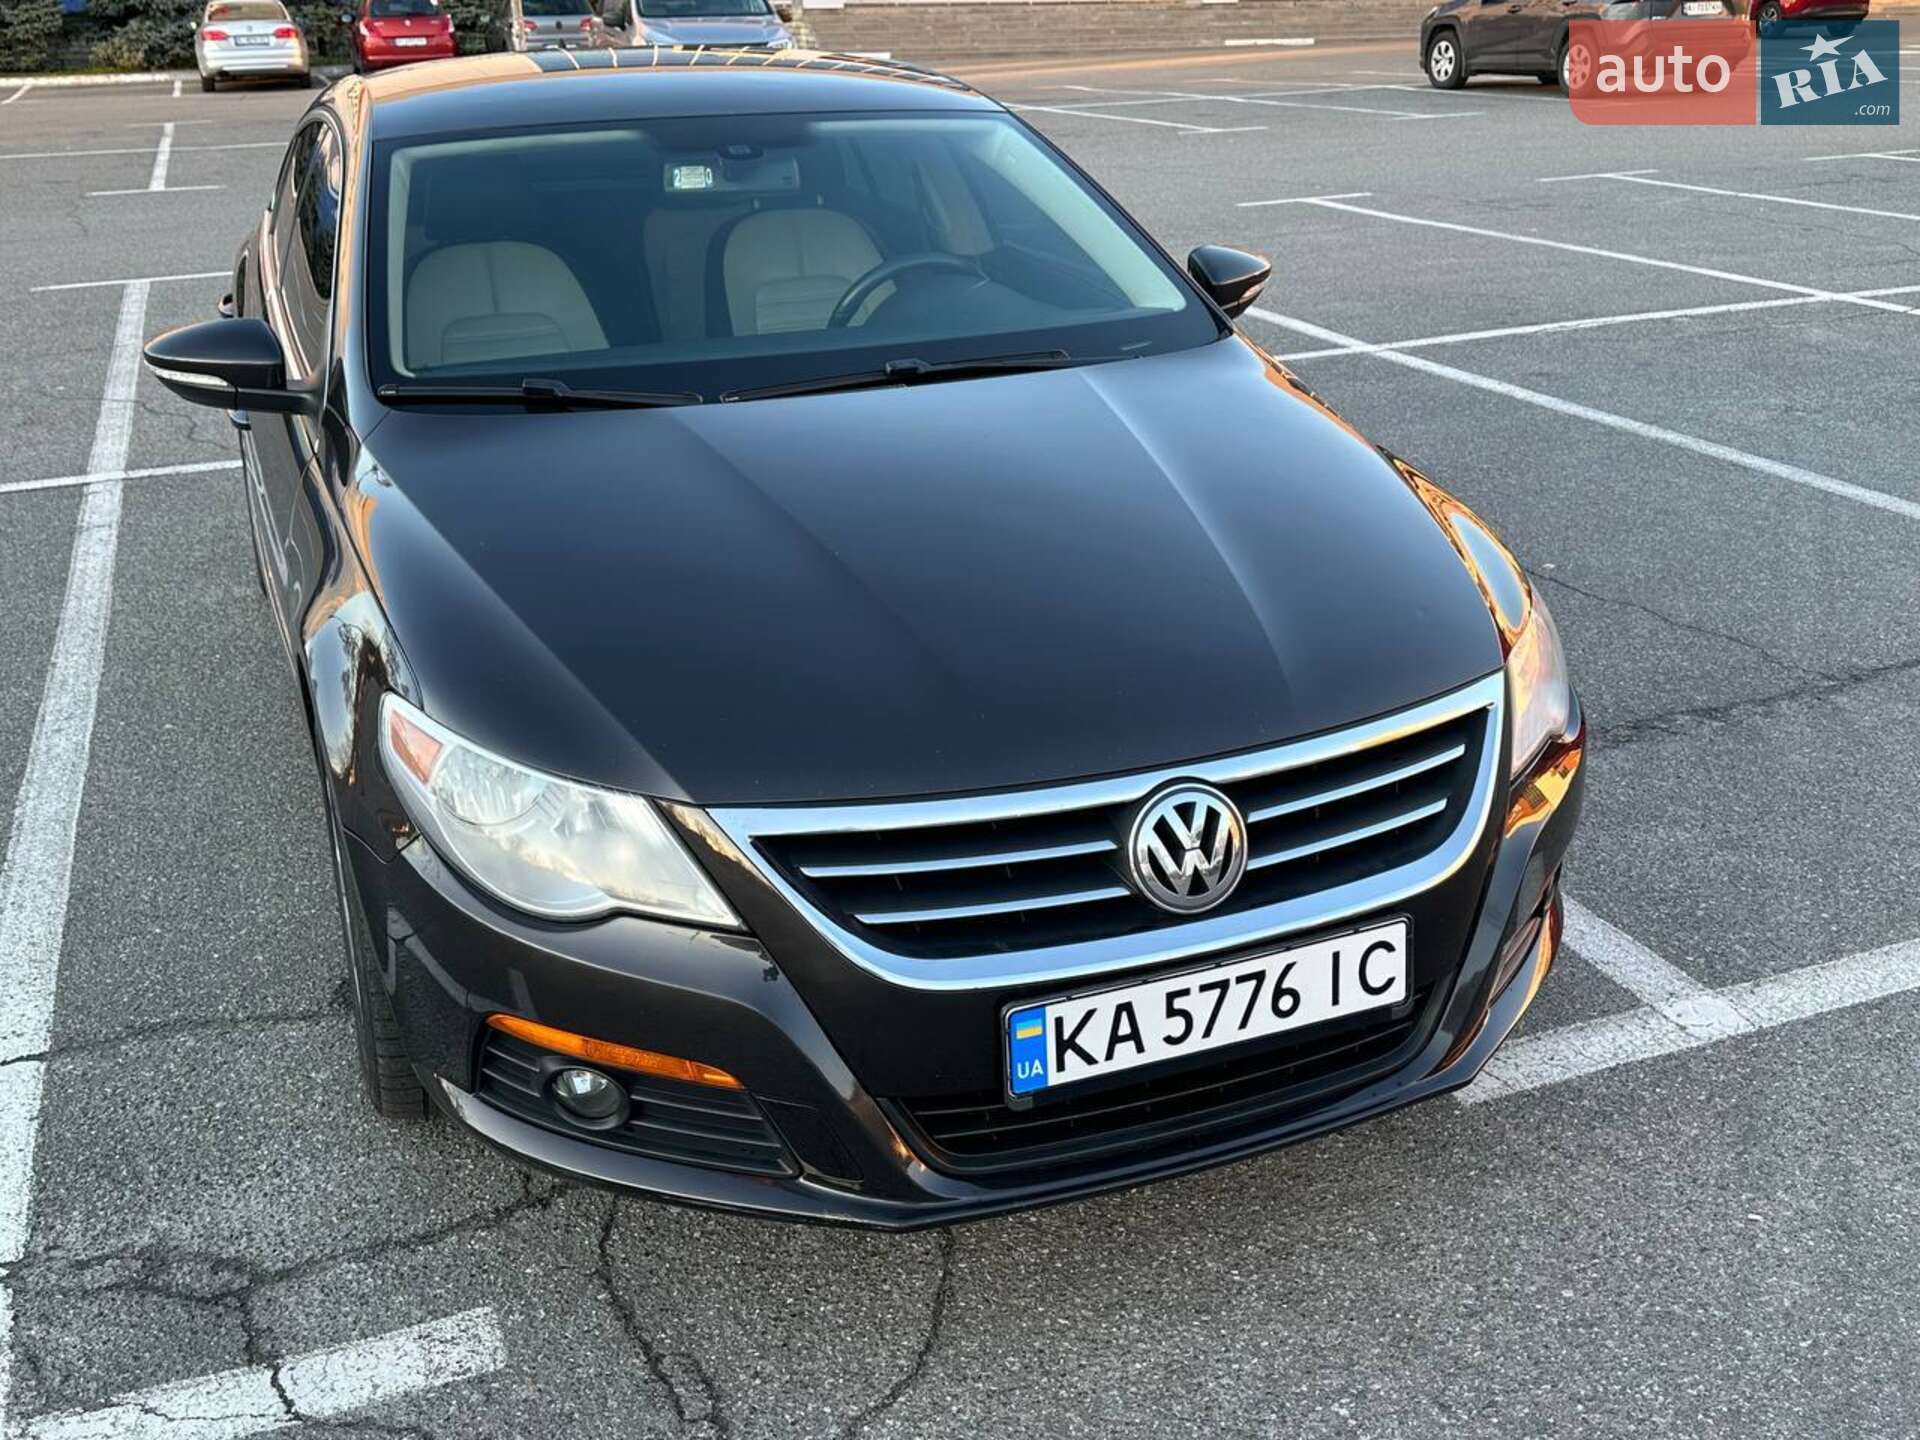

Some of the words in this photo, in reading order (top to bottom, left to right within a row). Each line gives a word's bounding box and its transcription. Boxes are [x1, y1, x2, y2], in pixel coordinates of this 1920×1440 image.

[1053, 1001, 1146, 1073] KA
[1162, 961, 1301, 1047] 5776
[1331, 940, 1397, 1007] IC
[1017, 1058, 1044, 1080] UA
